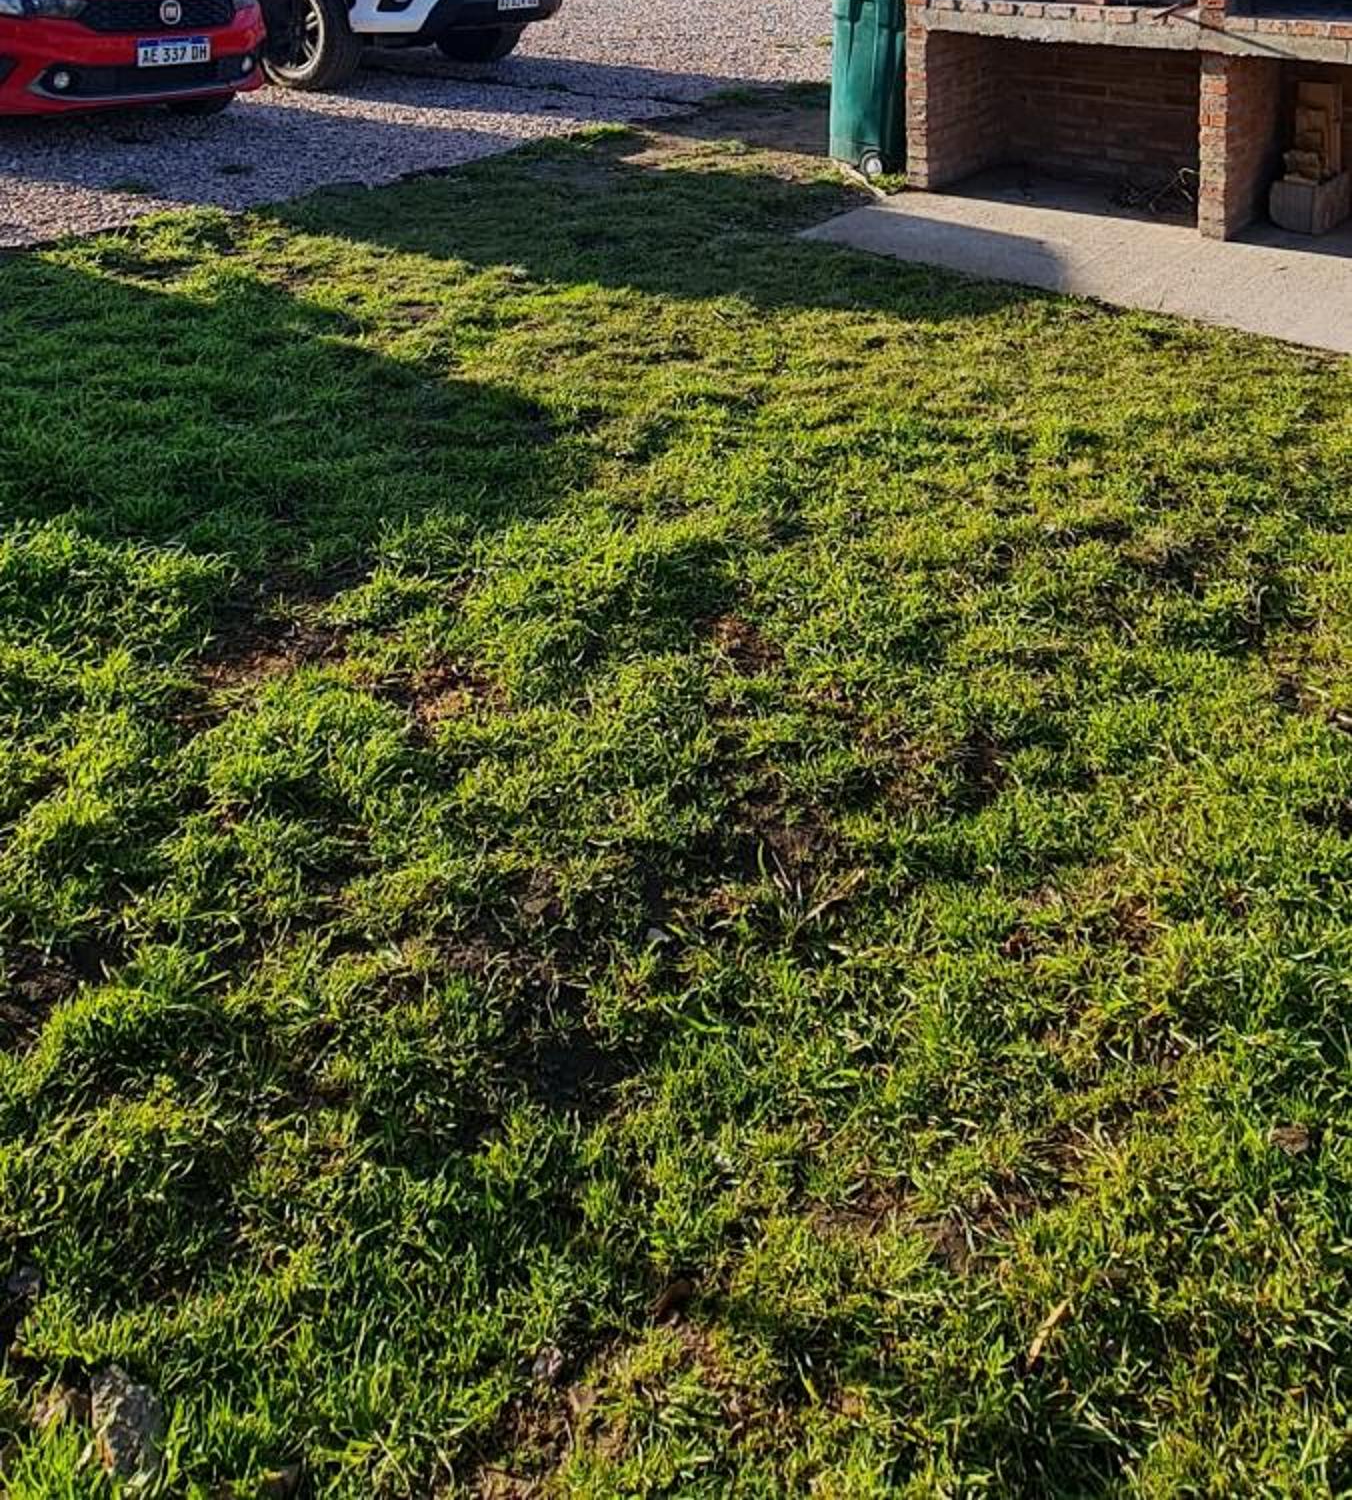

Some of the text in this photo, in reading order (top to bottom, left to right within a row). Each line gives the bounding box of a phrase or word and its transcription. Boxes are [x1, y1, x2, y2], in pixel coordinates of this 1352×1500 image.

[143, 45, 207, 63] AE 337 DH
